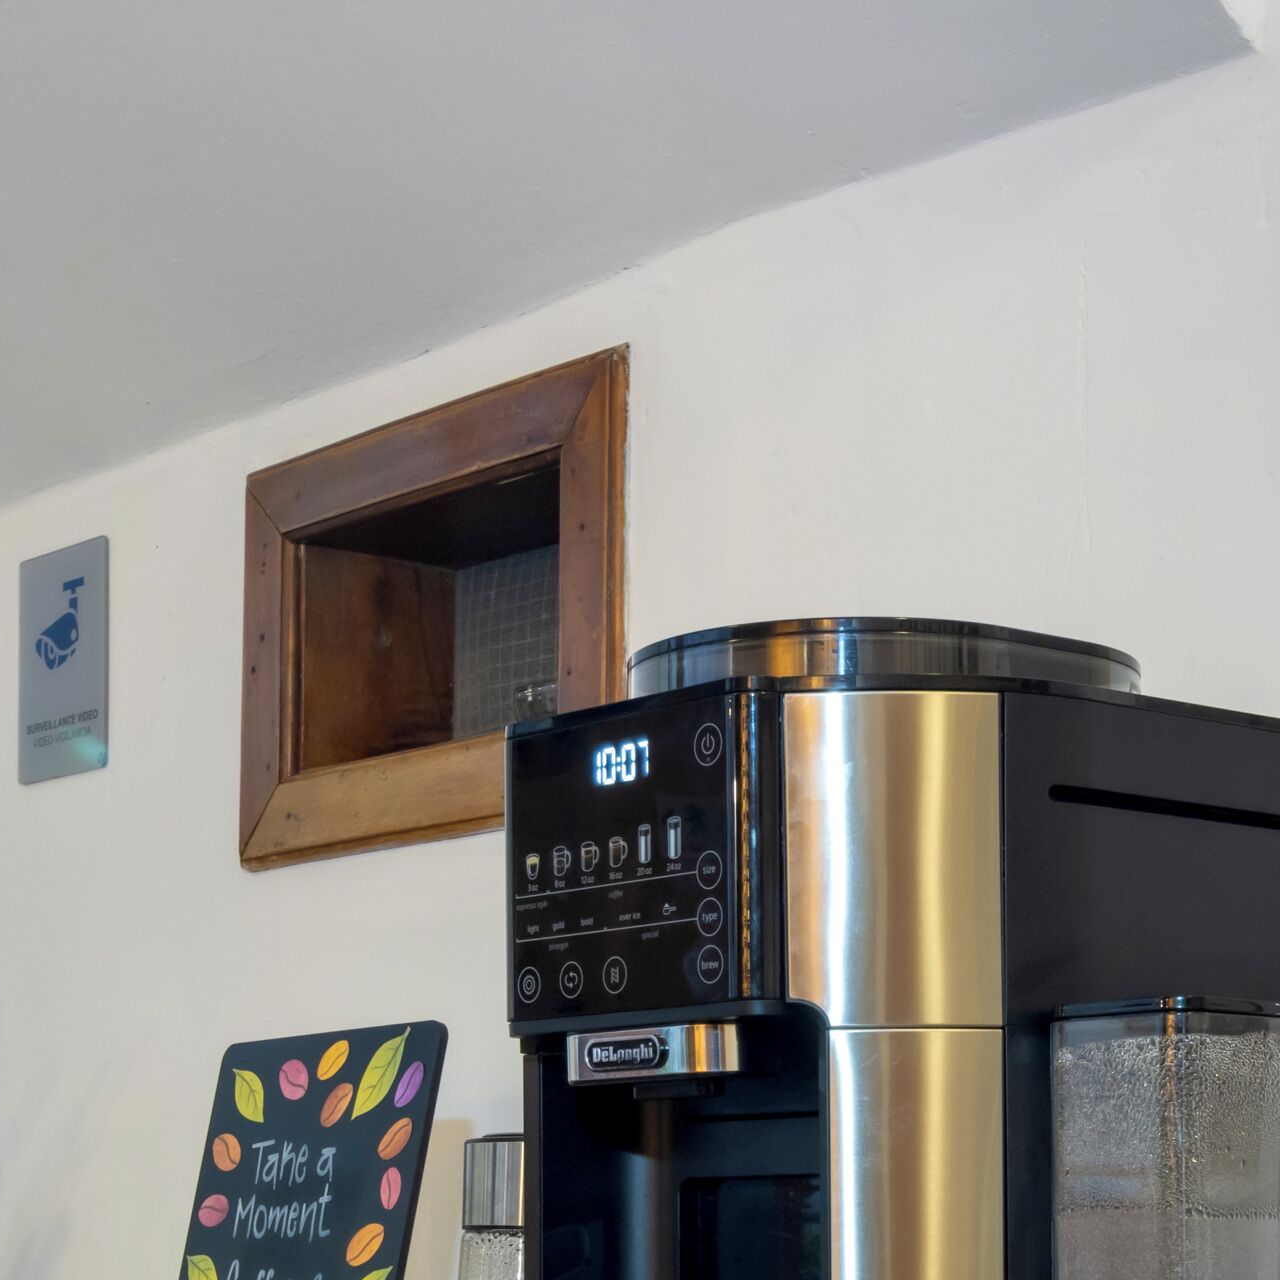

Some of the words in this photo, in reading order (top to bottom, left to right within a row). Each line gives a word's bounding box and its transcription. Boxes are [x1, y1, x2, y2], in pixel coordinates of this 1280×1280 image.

[595, 739, 650, 786] 10:07
[702, 864, 716, 875] size
[580, 917, 593, 926] bold
[702, 911, 718, 923] type
[702, 960, 719, 970] brew
[251, 1139, 309, 1191] Take
[316, 1146, 336, 1182] a
[232, 1182, 332, 1243] Moment
